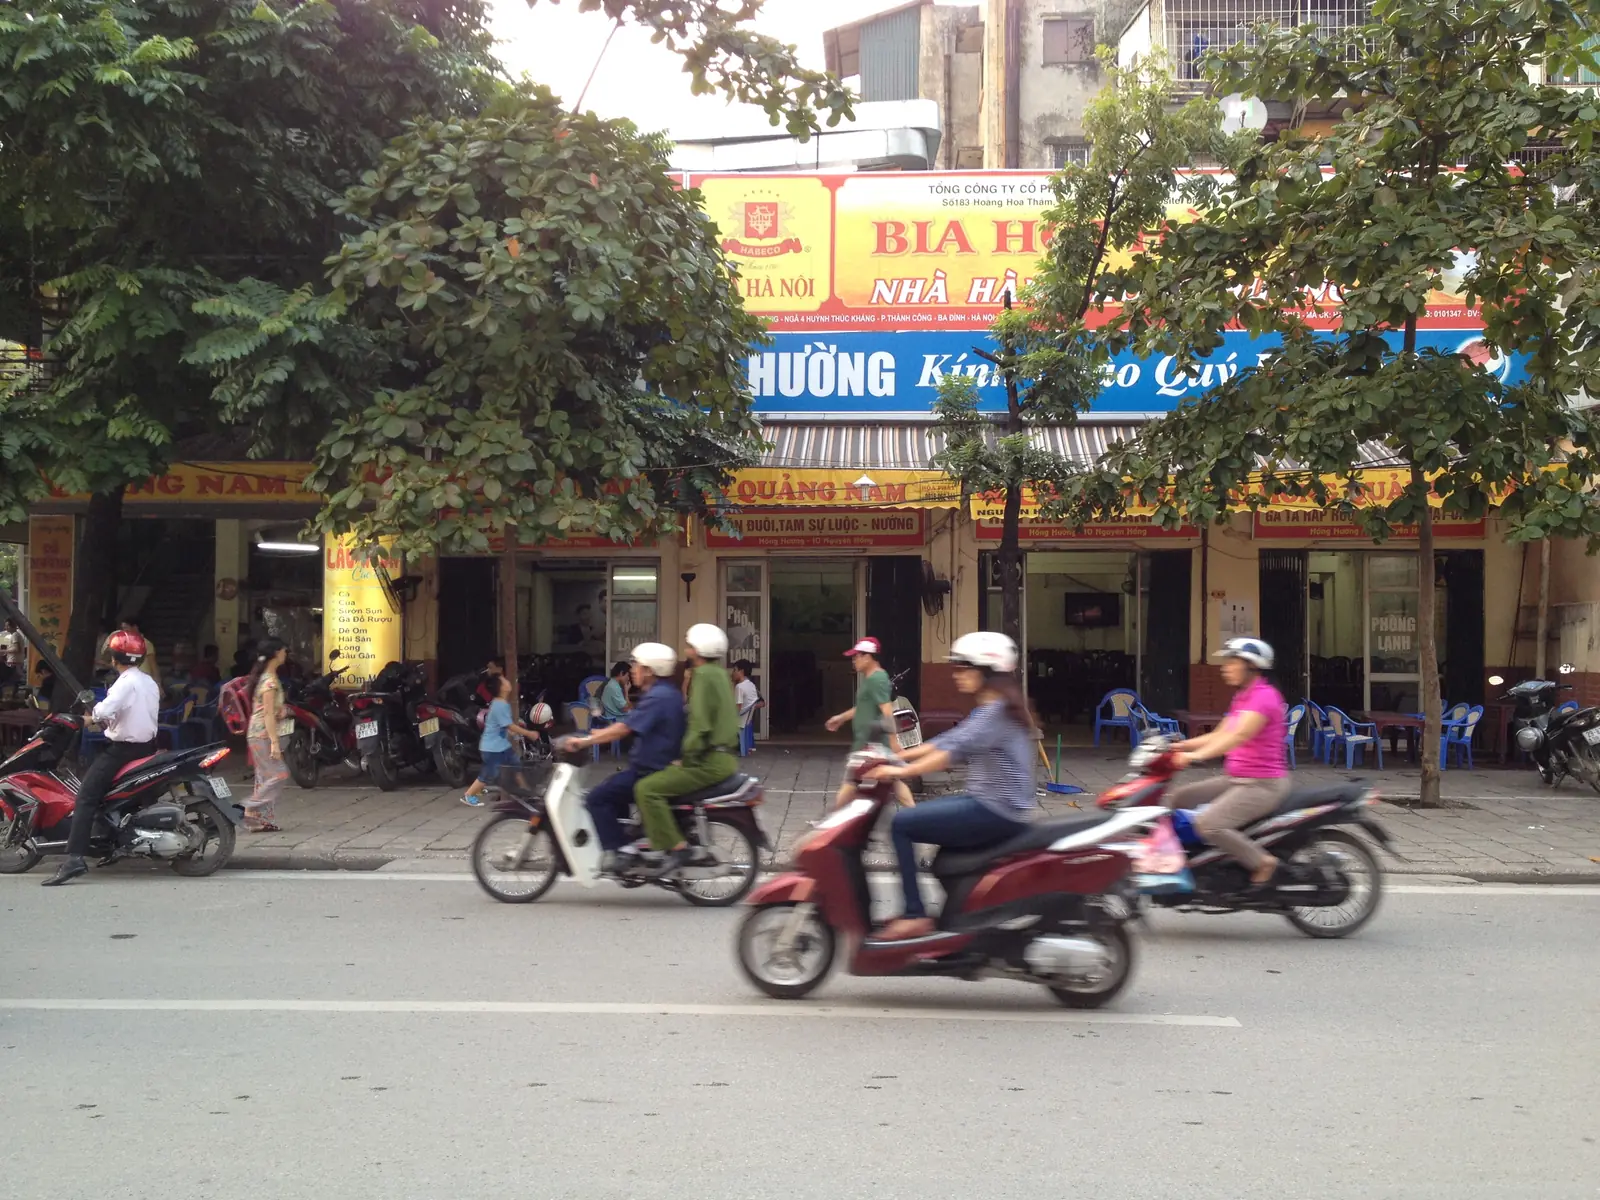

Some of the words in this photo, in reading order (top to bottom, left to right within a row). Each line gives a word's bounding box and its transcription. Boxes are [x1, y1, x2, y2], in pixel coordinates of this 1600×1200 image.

[964, 182, 997, 194] CÔNG
[1002, 184, 1015, 193] TY
[871, 220, 976, 254] BIA
[740, 245, 781, 256] HABECO
[746, 275, 775, 297] HÀ
[780, 274, 815, 300] NỘI
[868, 268, 949, 305] NHÀ
[800, 315, 805, 323] 4
[912, 313, 932, 322] CÔNG
[971, 313, 981, 321] HÀ
[1433, 310, 1462, 318] 0101347
[748, 342, 896, 397] HƯỜNG
[196, 475, 286, 496] NAM
[737, 473, 836, 503] QUẢNG
[844, 481, 907, 502] NAM
[347, 674, 365, 685] Om
